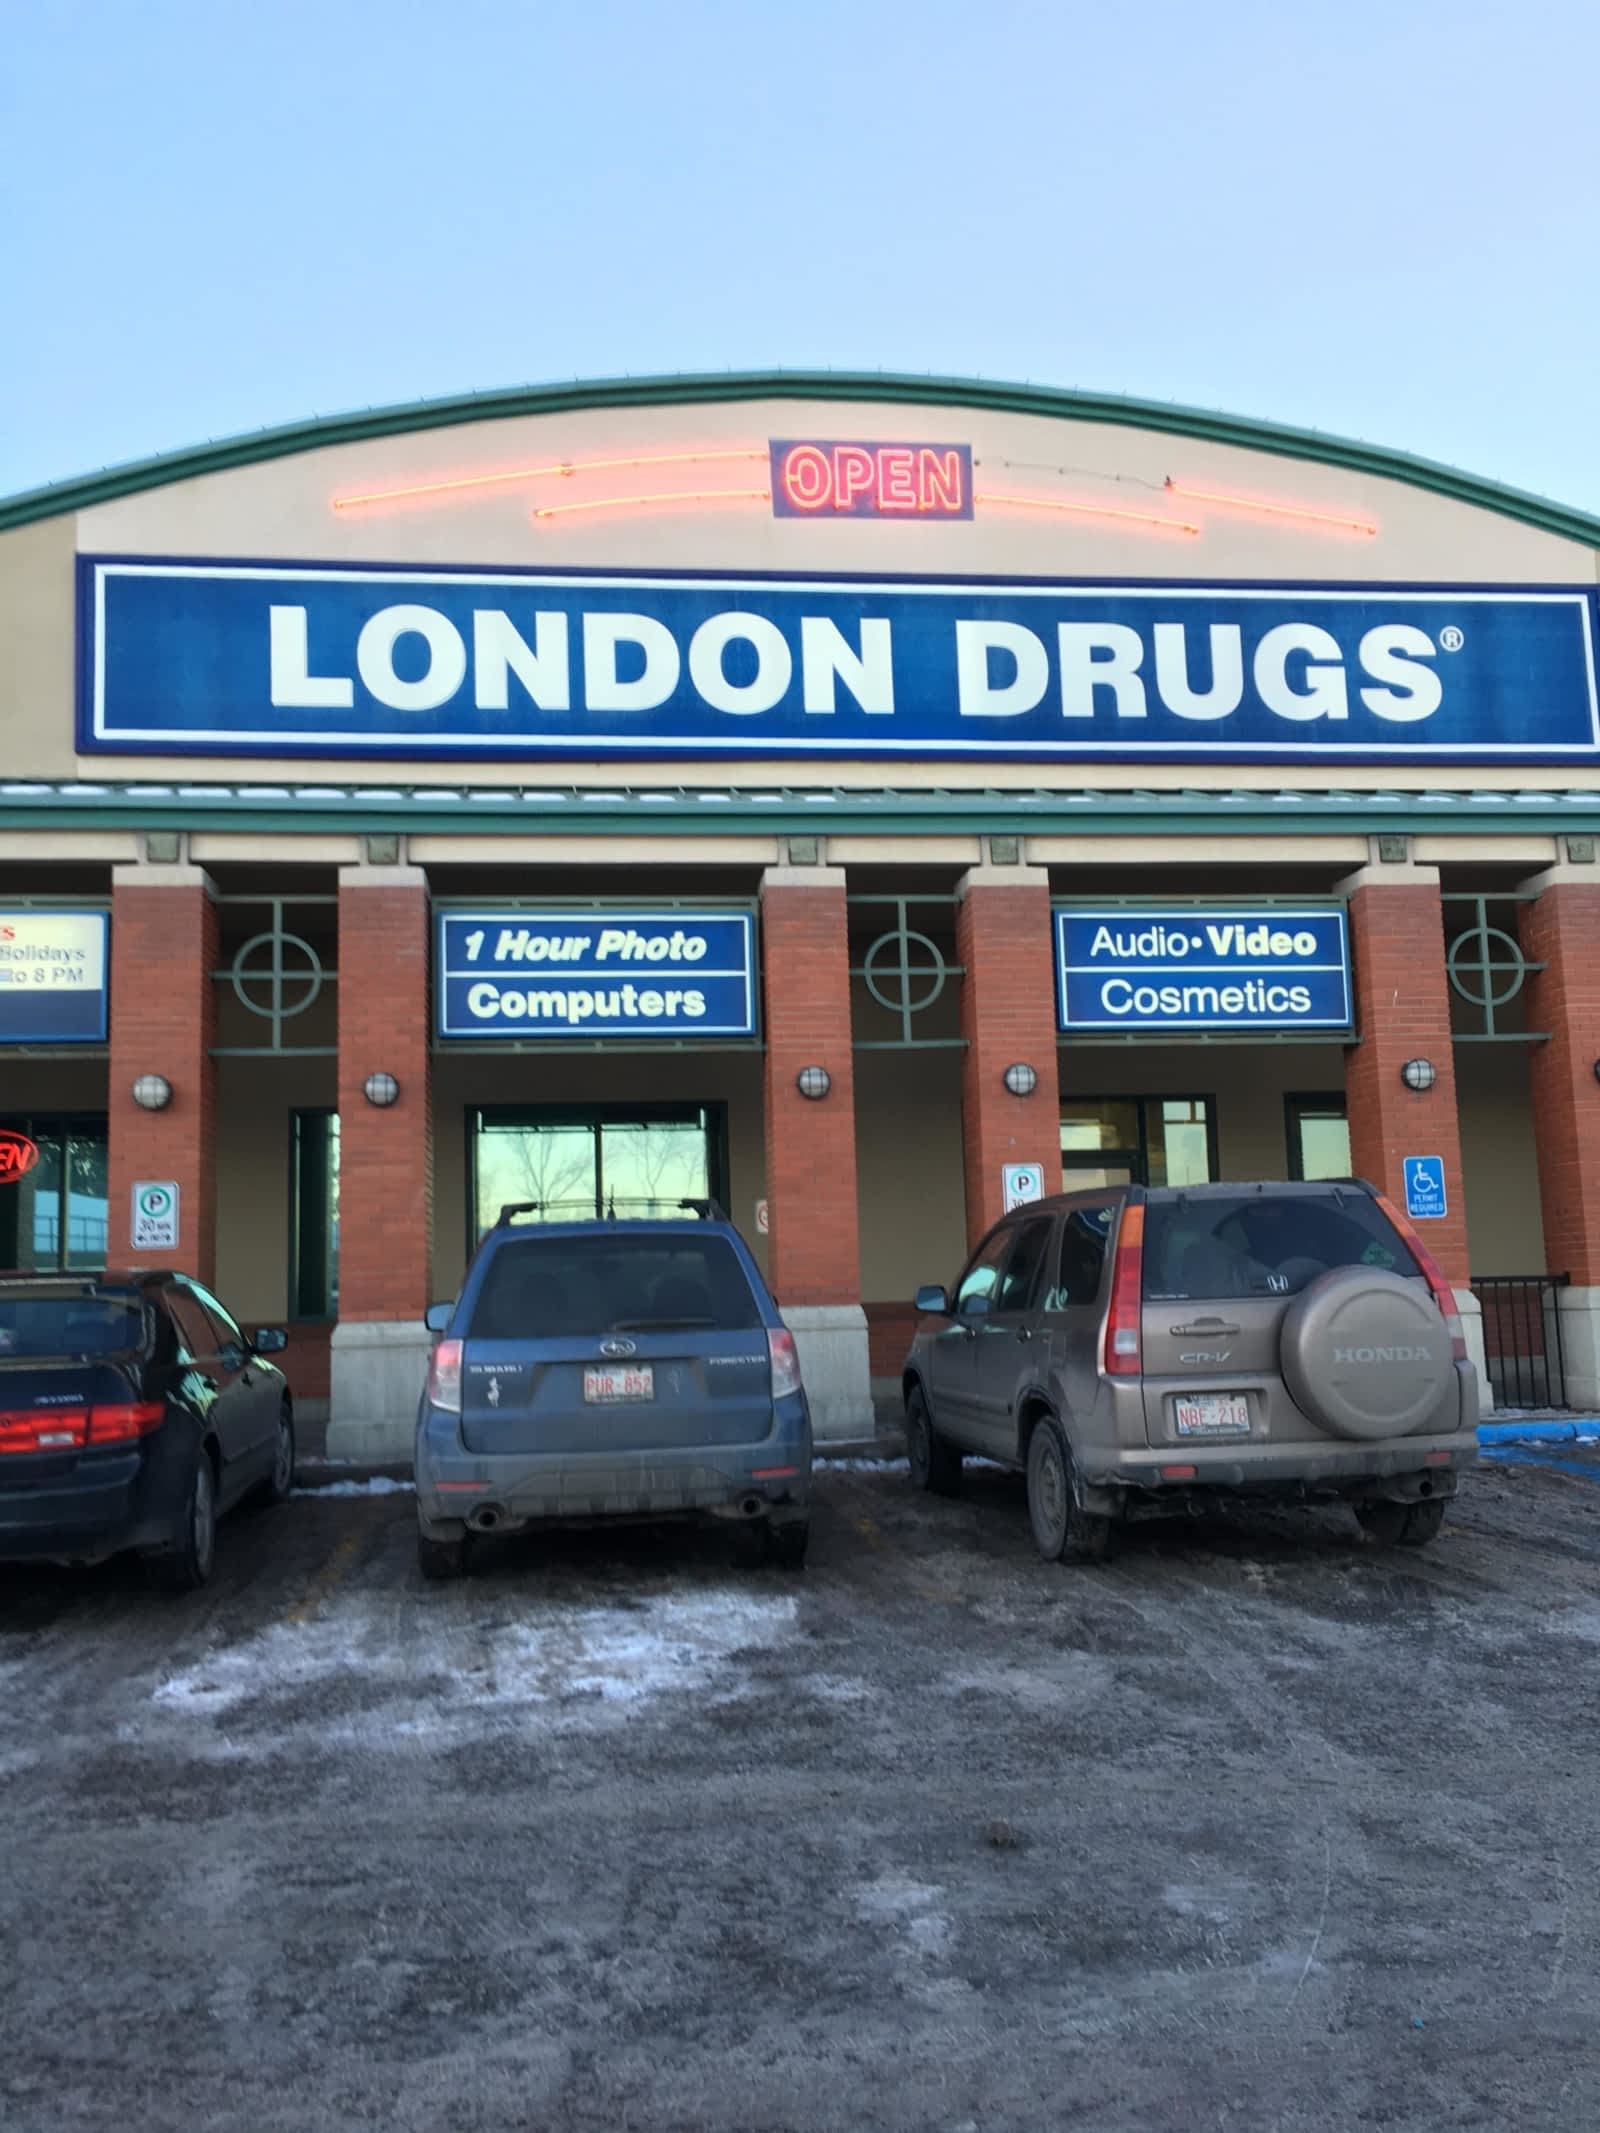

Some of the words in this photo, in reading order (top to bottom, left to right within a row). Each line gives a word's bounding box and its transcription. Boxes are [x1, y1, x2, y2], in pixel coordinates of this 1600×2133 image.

[786, 445, 962, 510] OPEN
[270, 605, 894, 714] LONDON
[465, 930, 485, 961] 1
[495, 930, 591, 961] Hour
[595, 930, 707, 961] Photo
[34, 967, 46, 983] 8
[52, 967, 84, 983] PM
[467, 983, 706, 1024] Computers
[1101, 979, 1312, 1014] Cosmetics
[1018, 1176, 1029, 1190] P
[150, 1193, 163, 1210] P
[1333, 1346, 1433, 1362] HONDA
